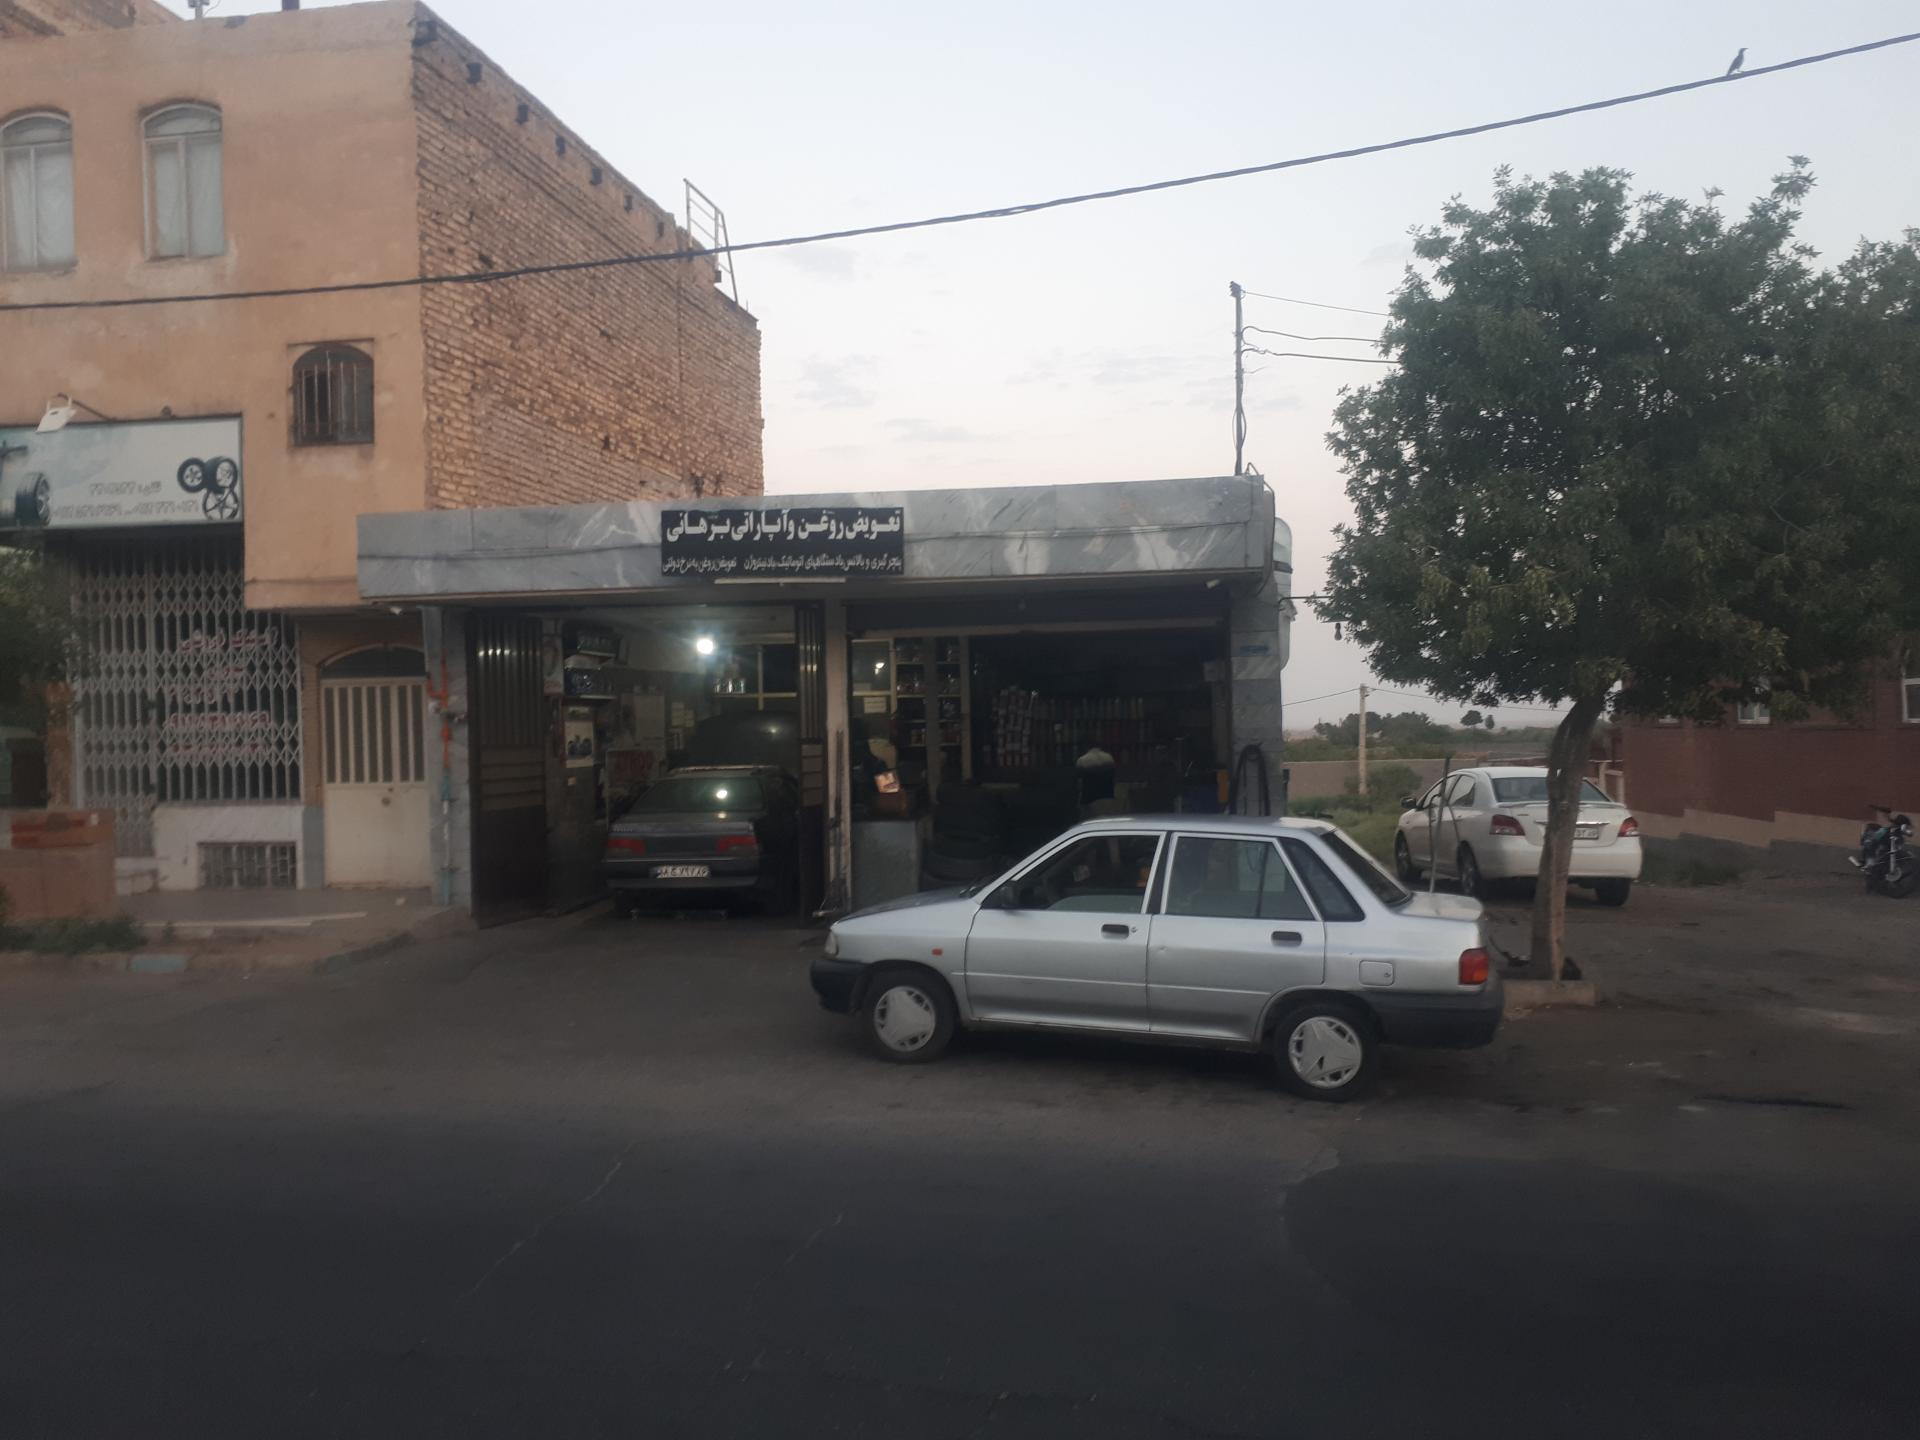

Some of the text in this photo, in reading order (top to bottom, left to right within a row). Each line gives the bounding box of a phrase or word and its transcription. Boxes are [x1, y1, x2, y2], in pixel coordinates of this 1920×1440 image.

[666, 511, 731, 542] برهانی
[798, 509, 844, 540] روغن
[846, 509, 901, 540] تعویض
